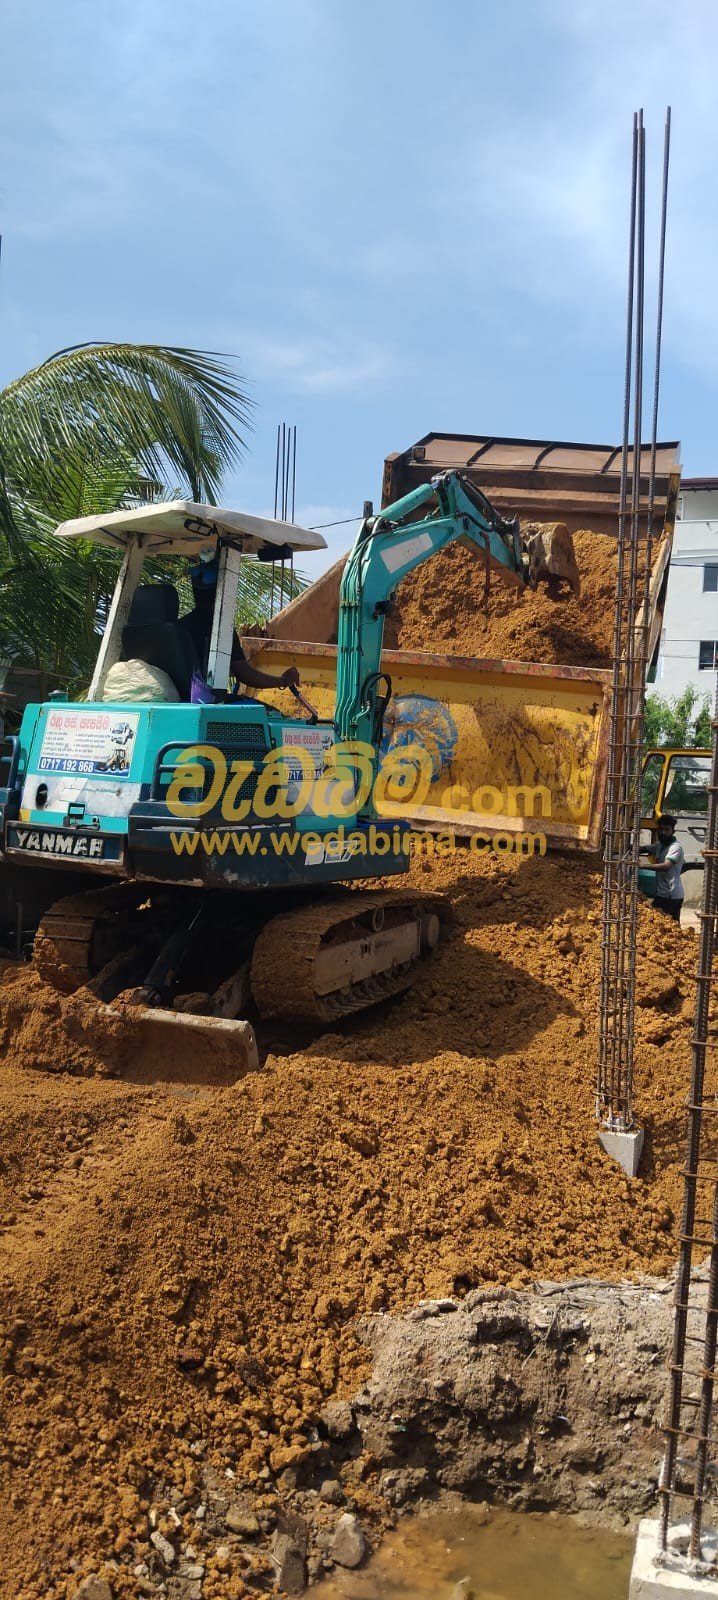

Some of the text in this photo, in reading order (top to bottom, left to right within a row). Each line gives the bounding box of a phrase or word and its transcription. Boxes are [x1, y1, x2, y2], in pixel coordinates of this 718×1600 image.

[41, 758, 94, 772] 0717 192 868
[16, 829, 103, 857] YANMAR
